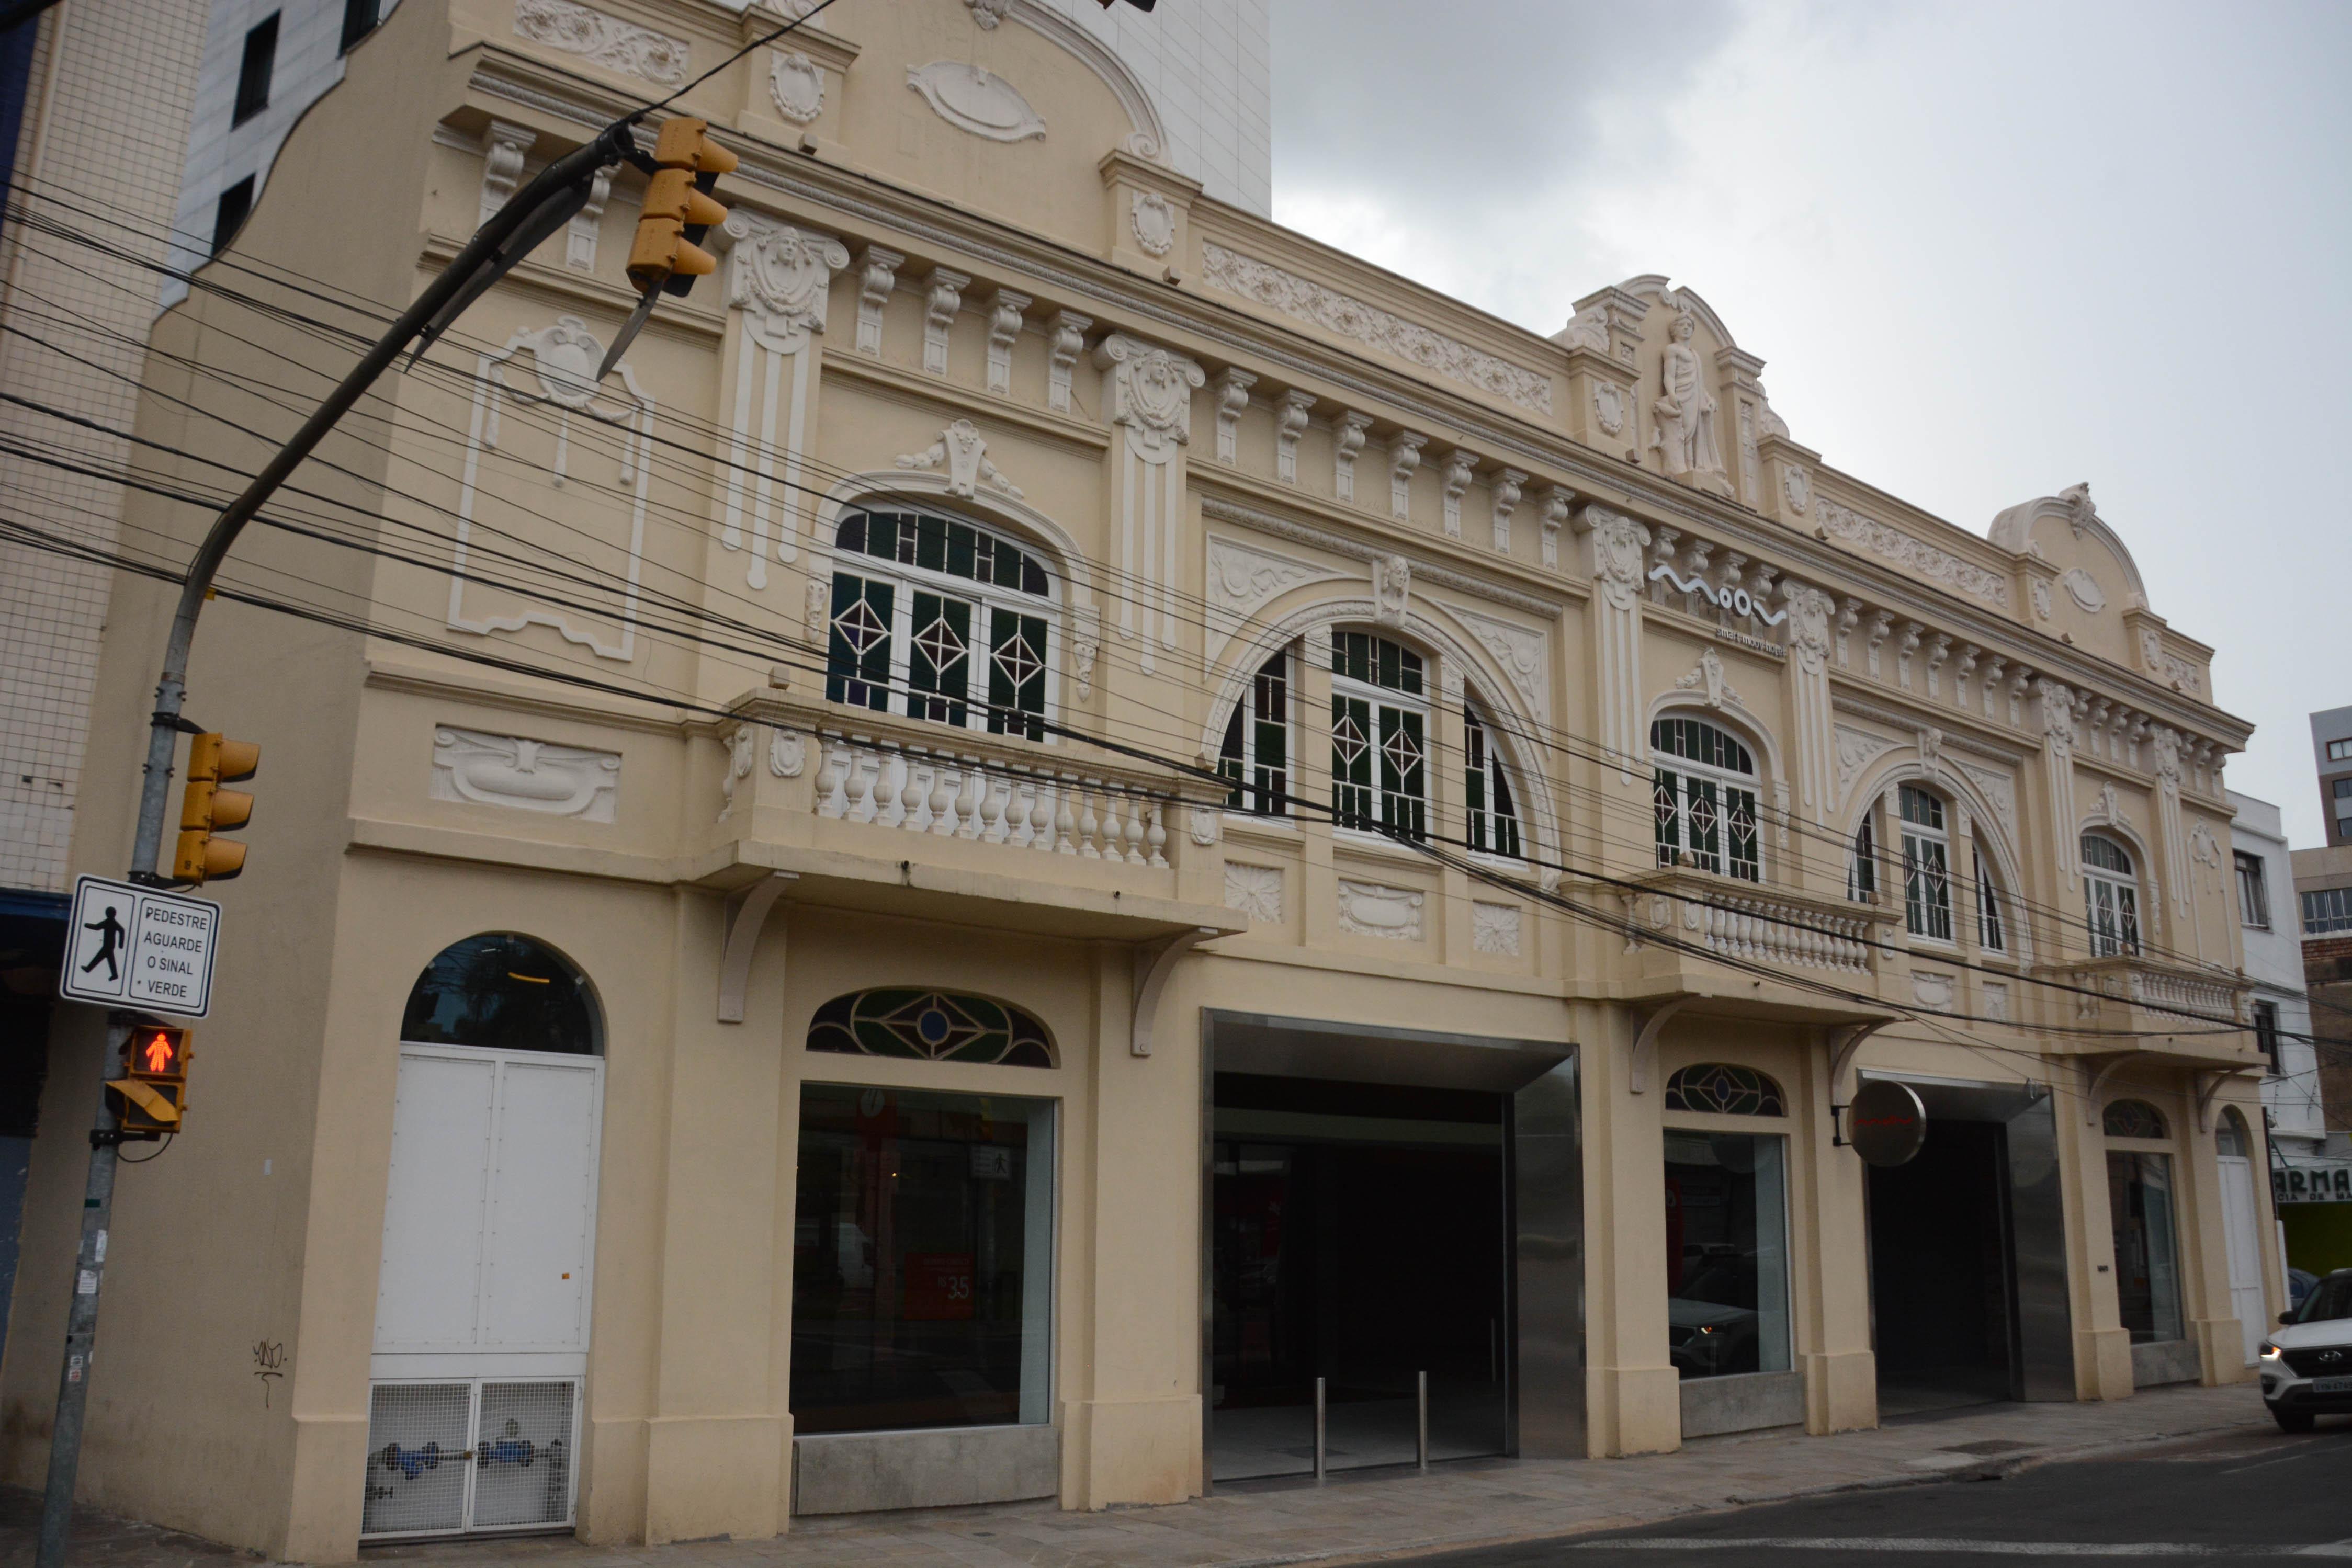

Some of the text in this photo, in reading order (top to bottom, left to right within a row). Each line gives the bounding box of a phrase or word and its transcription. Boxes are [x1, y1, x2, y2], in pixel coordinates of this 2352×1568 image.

[145, 906, 208, 930] PEDESTRE
[144, 931, 202, 952] AGUARDE
[147, 956, 193, 975] O SINAL
[148, 980, 187, 998] VERDE
